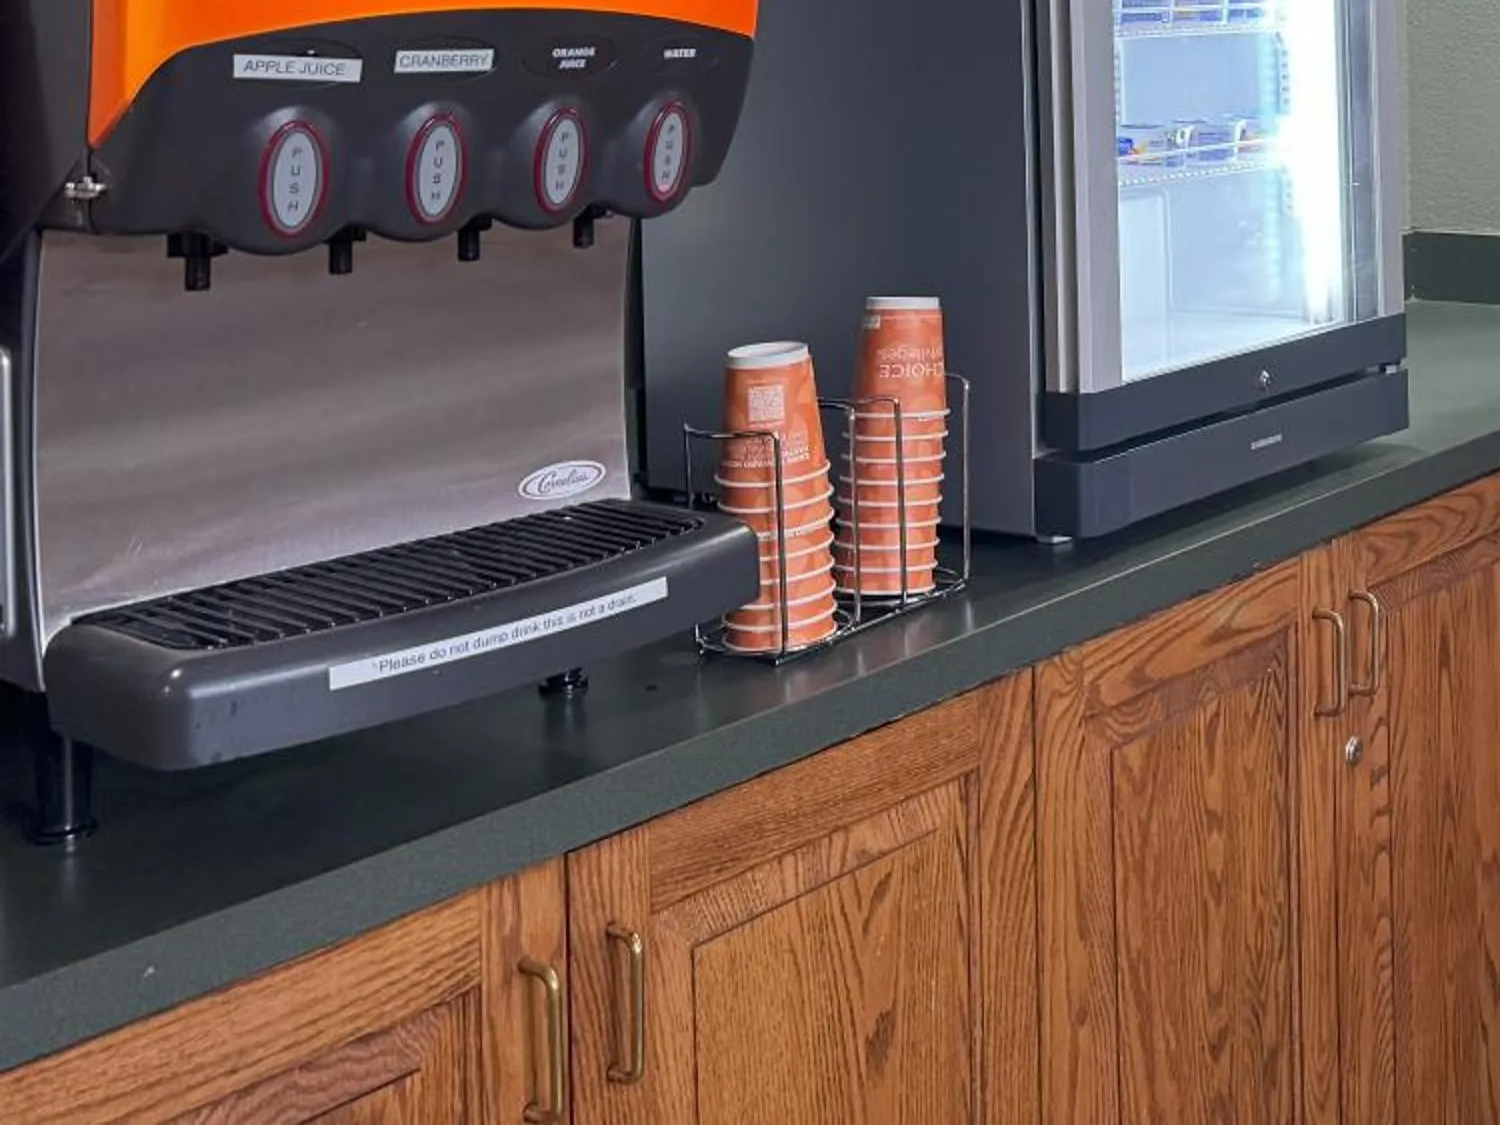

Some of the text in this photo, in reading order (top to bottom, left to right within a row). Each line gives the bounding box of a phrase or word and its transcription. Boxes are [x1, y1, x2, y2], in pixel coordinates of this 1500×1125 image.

[243, 60, 346, 76] APPLE JUICE
[400, 52, 490, 68] CRANBERRY
[552, 47, 597, 59] ORANGE
[287, 148, 302, 213] PUSH
[431, 140, 445, 201] PUSH
[555, 131, 571, 191] PUSH
[429, 646, 447, 660] do
[450, 640, 470, 656] not
[473, 632, 509, 652] dump
[512, 621, 539, 640] drink
[543, 614, 564, 630] this
[580, 604, 597, 620] not
